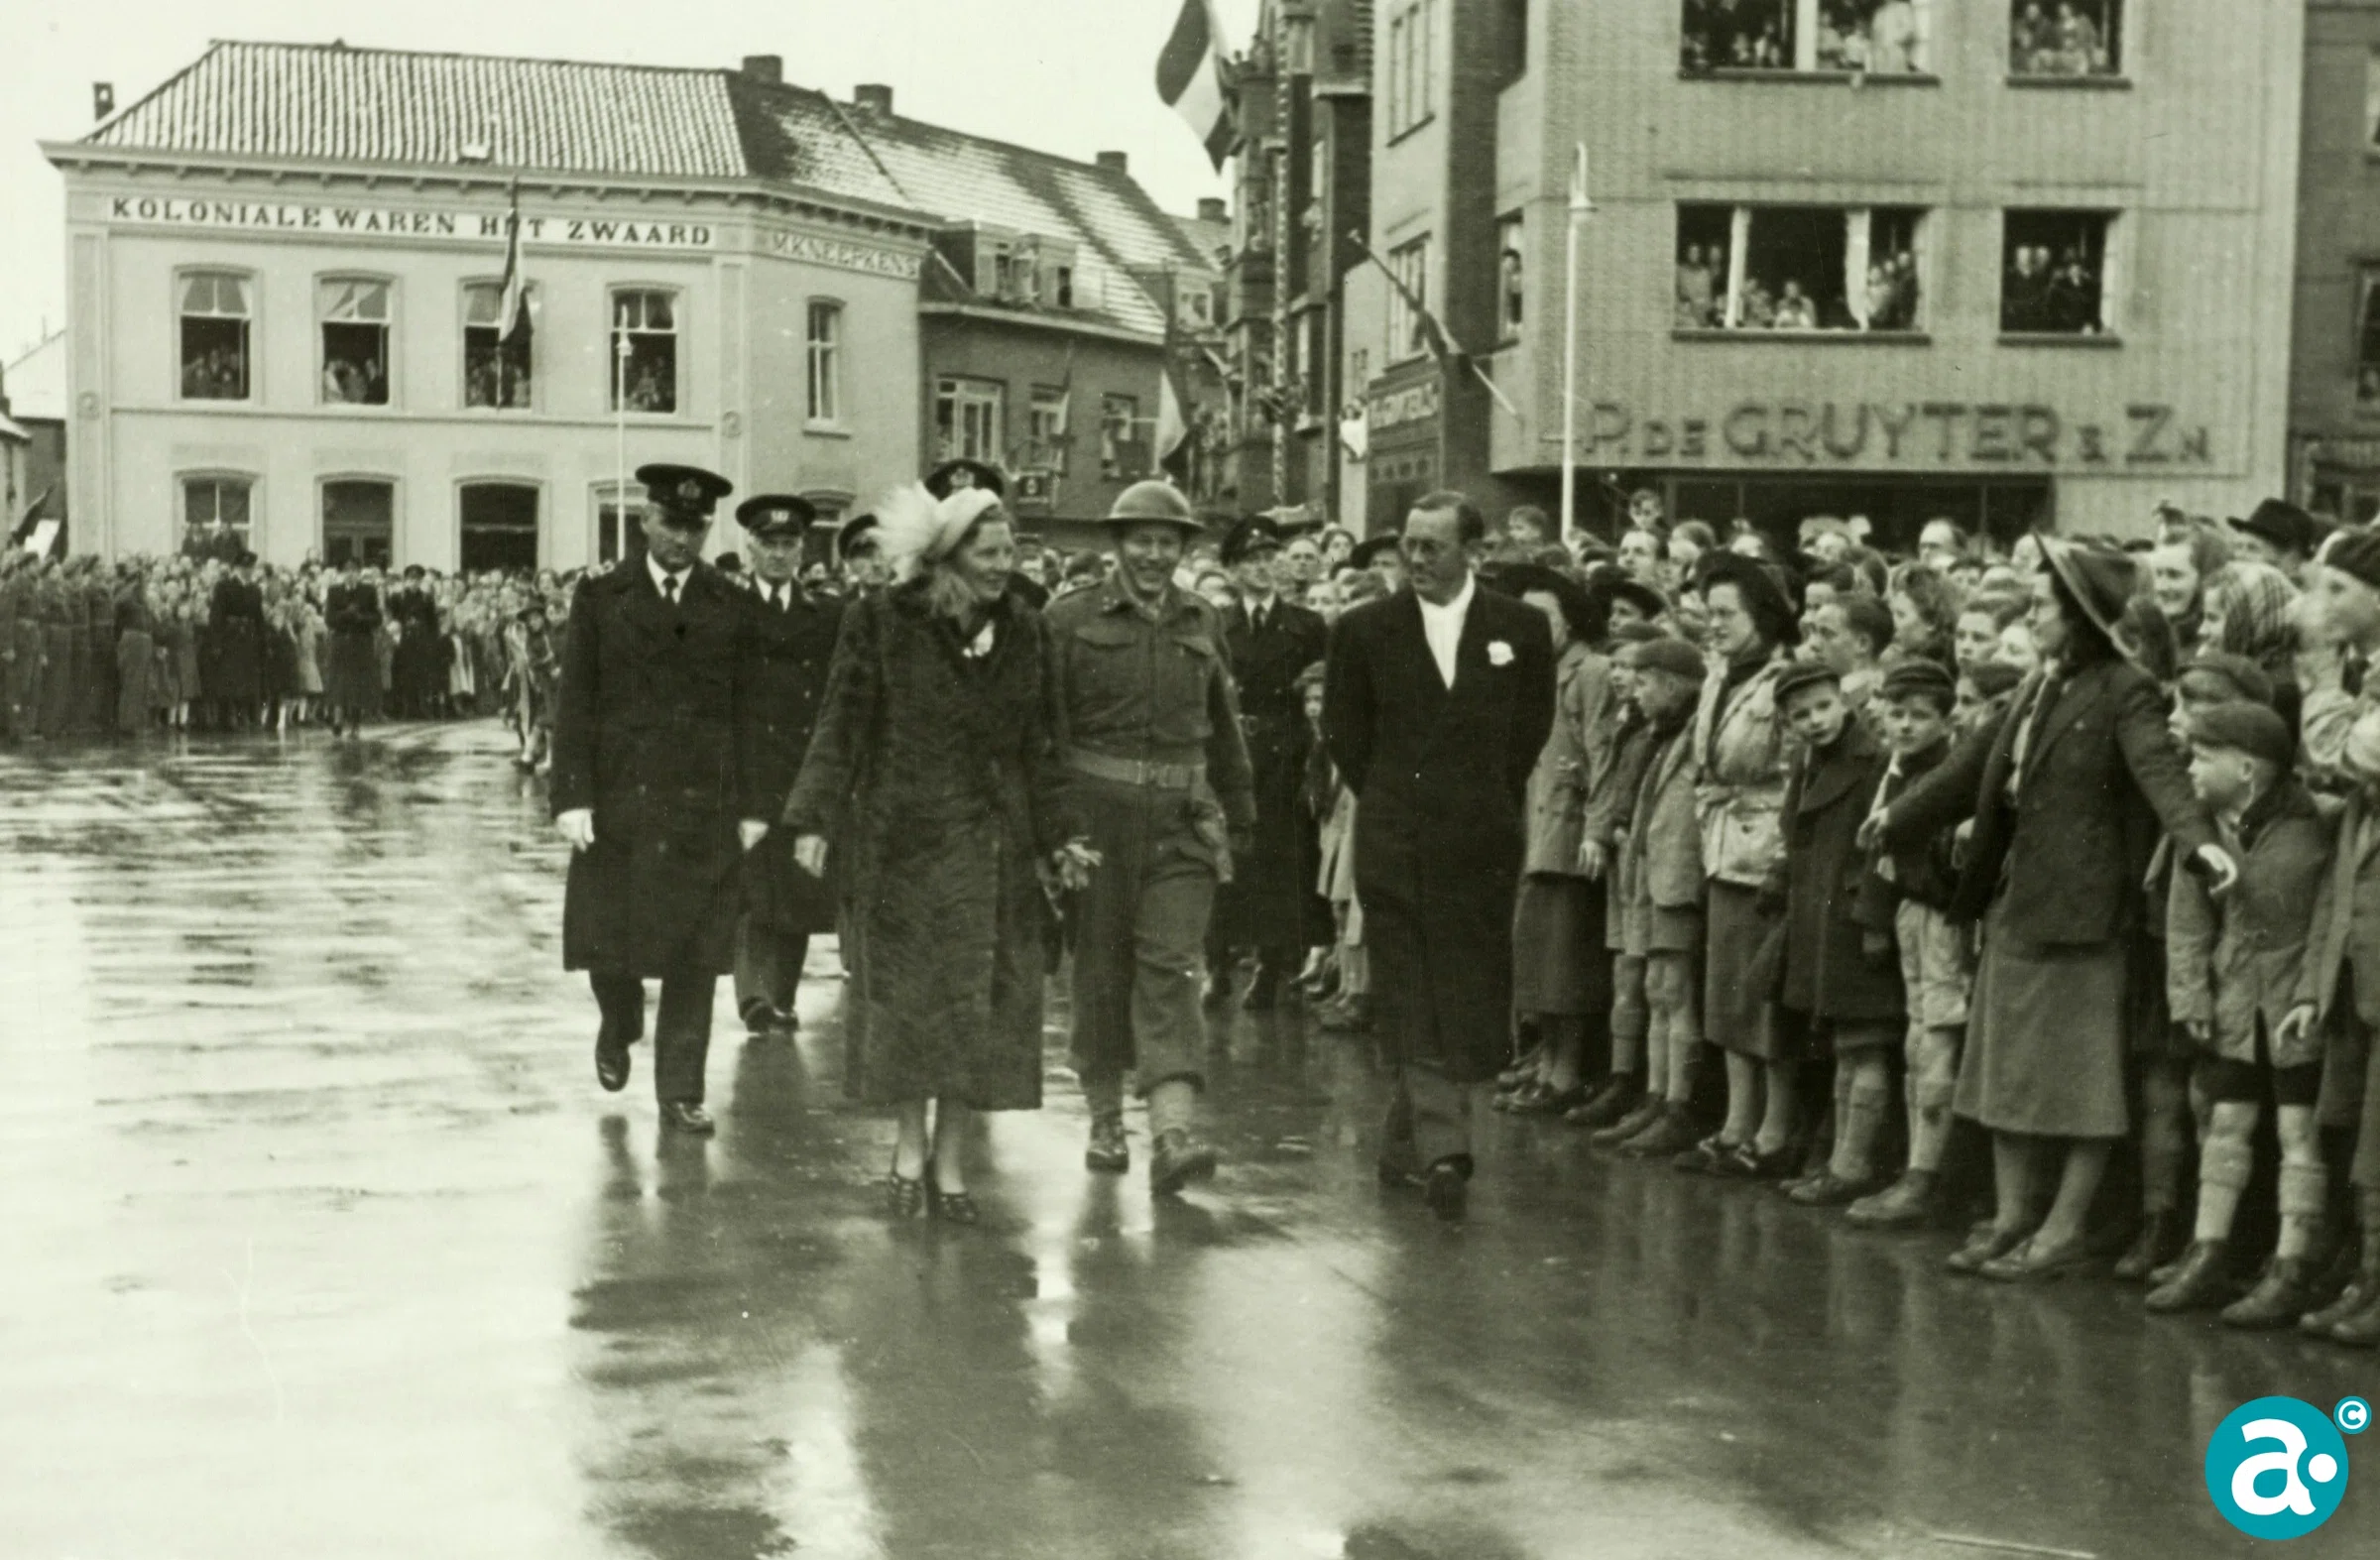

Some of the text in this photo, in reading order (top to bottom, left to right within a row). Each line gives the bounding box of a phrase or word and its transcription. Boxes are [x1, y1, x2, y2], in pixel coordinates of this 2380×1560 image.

[112, 197, 321, 228] KOLONIALE
[333, 208, 455, 235] WAREN
[567, 218, 710, 245] ZWAARD
[1642, 419, 1708, 457] DE
[1723, 401, 2059, 464] GRUYTER
